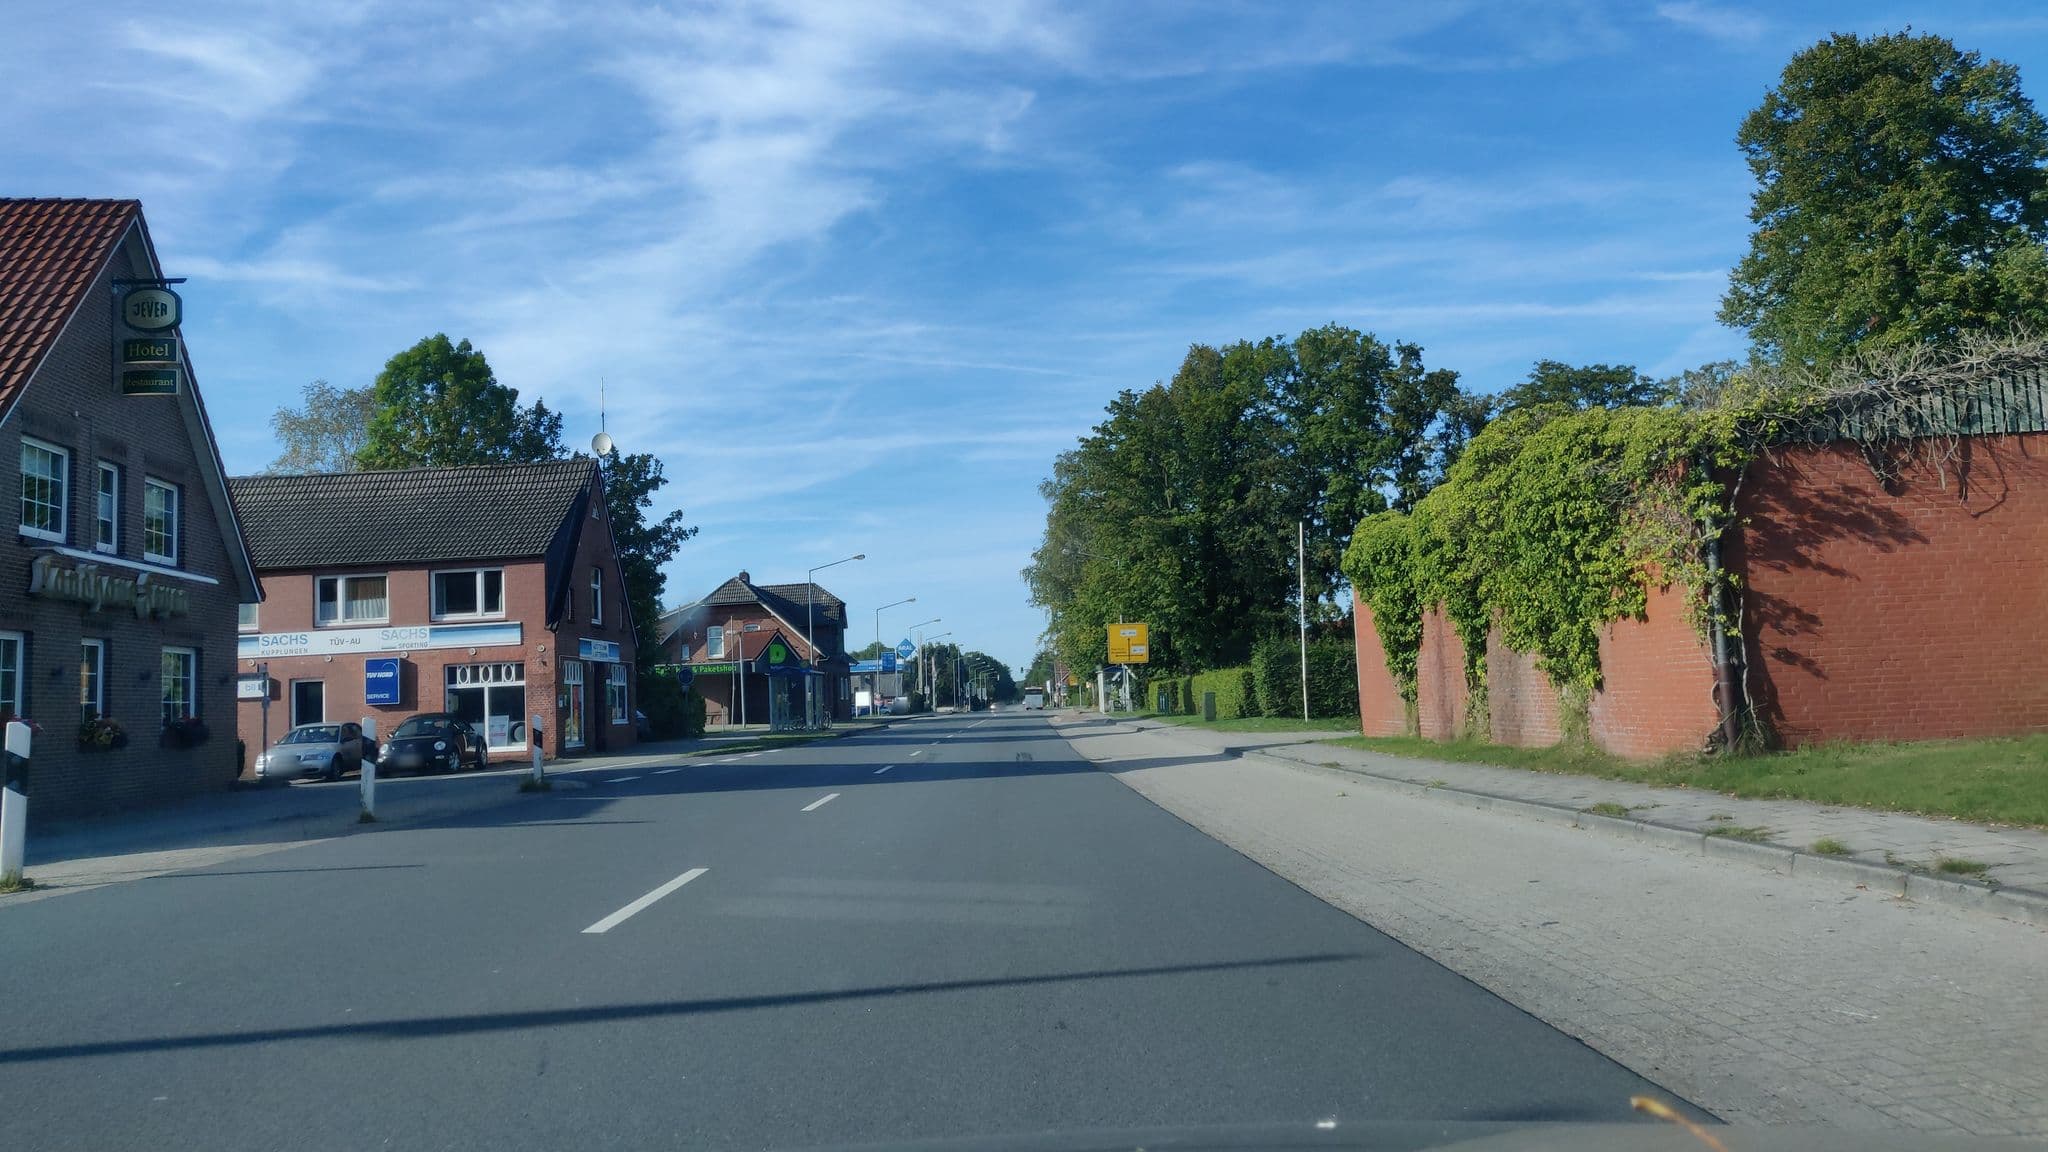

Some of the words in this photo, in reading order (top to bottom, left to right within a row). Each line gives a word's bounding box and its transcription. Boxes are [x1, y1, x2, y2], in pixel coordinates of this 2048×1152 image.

[133, 301, 167, 317] JEVER
[129, 344, 169, 356] Hotel
[381, 628, 427, 640] SACHS
[261, 634, 308, 647] SACHS
[398, 641, 428, 649] SPORTING
[261, 648, 308, 656] KUPPLUNGEN
